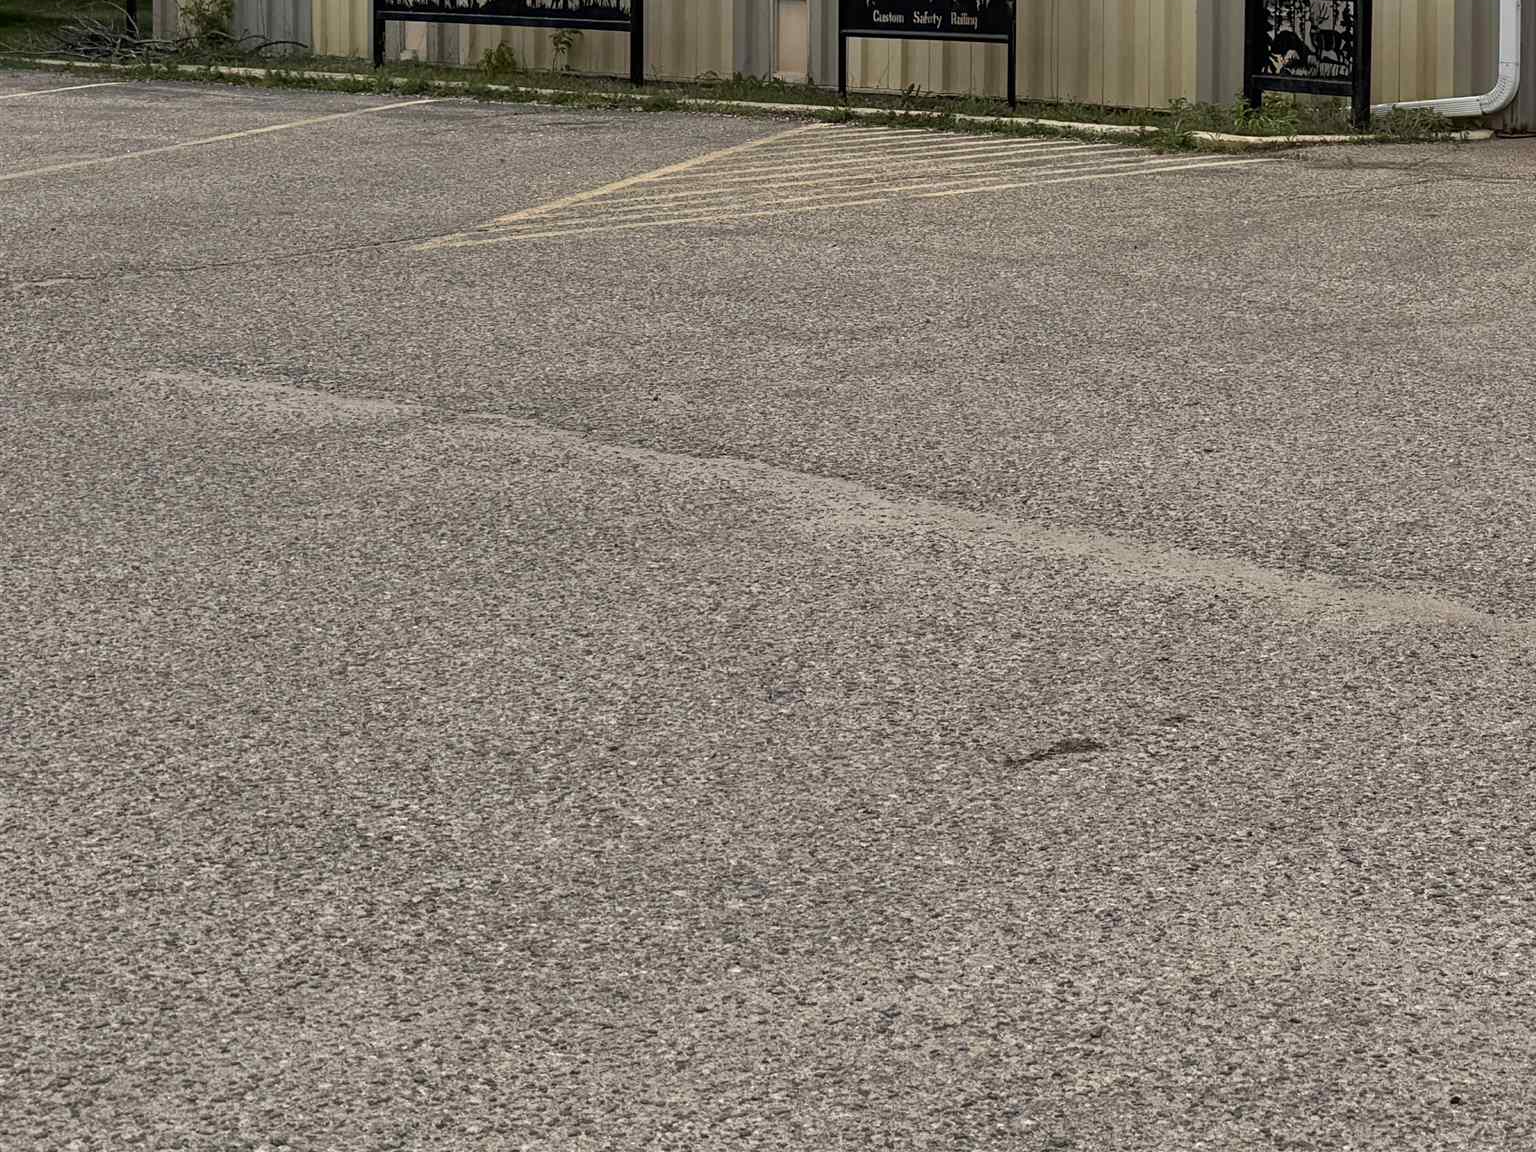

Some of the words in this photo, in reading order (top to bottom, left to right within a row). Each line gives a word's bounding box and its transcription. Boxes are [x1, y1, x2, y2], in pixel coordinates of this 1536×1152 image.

[872, 9, 905, 24] Custom
[913, 10, 942, 29] Safety
[950, 11, 978, 30] Railing
